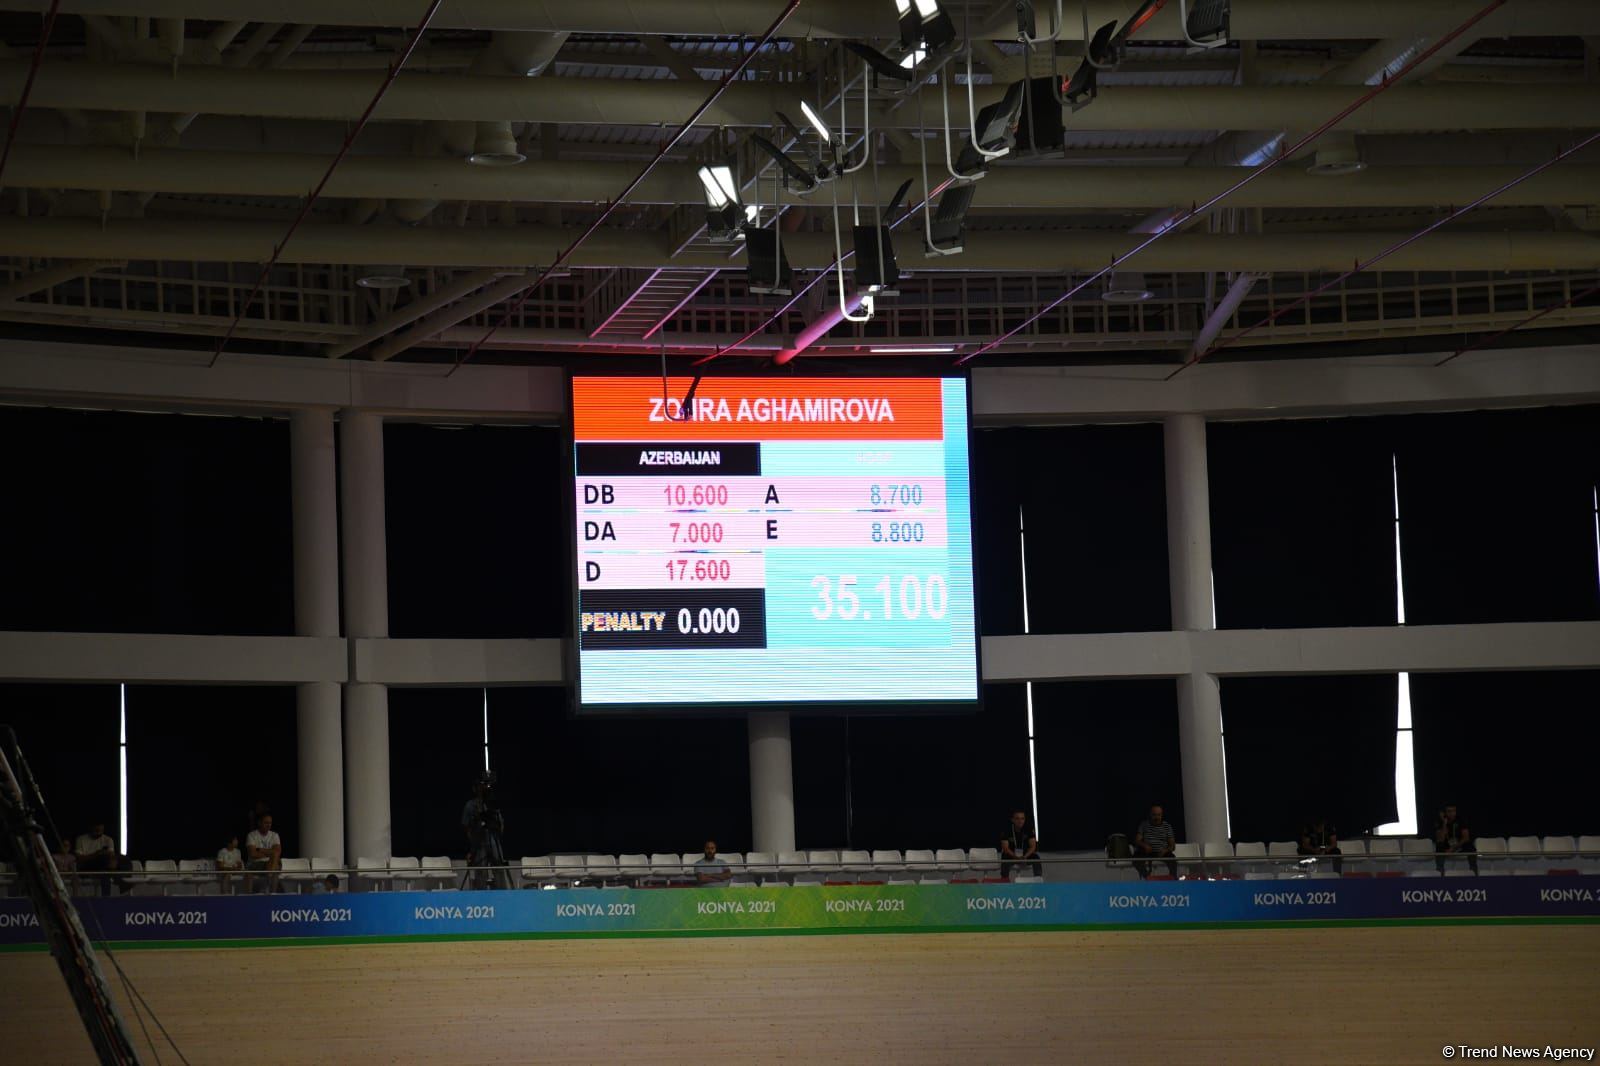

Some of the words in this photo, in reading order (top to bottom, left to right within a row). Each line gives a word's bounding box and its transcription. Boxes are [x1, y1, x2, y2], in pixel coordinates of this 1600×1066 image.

[736, 397, 895, 422] AGHAMIROVA
[639, 450, 721, 466] AZERBAIJAN
[584, 484, 615, 504] DB
[664, 484, 728, 506] 10.600
[764, 484, 780, 504] A
[870, 484, 923, 506] 8.700
[584, 520, 617, 541] DA
[669, 522, 723, 543] 7.000
[766, 519, 778, 539] E
[871, 521, 924, 542] 8.800
[585, 560, 601, 582] D
[665, 559, 731, 581] 17.600
[810, 574, 948, 620] 35.100
[581, 611, 666, 632] PENALTY
[677, 607, 741, 634] 0.000
[1109, 895, 1158, 909] KONYA
[1160, 894, 1190, 908] 2021
[1254, 892, 1304, 906] KONYA
[1306, 892, 1337, 905] 2021
[1402, 890, 1453, 904] KONYA
[1455, 889, 1487, 903] 2021
[1540, 888, 1593, 902] KONYA
[556, 903, 604, 918] KONYA
[607, 903, 636, 917] 2021
[697, 900, 745, 915] KONYA
[747, 900, 776, 914] 2021
[825, 899, 873, 913] KONYA
[876, 898, 905, 912] 2021
[966, 897, 1015, 911] KONYA
[1017, 896, 1047, 910] 2021
[0, 913, 40, 927] ONYA
[125, 911, 175, 926] KONYA
[178, 910, 208, 925] 2021
[271, 909, 320, 923] KONYA
[322, 908, 352, 922] 2021
[414, 905, 463, 920] KONYA
[466, 905, 495, 919] 2021
